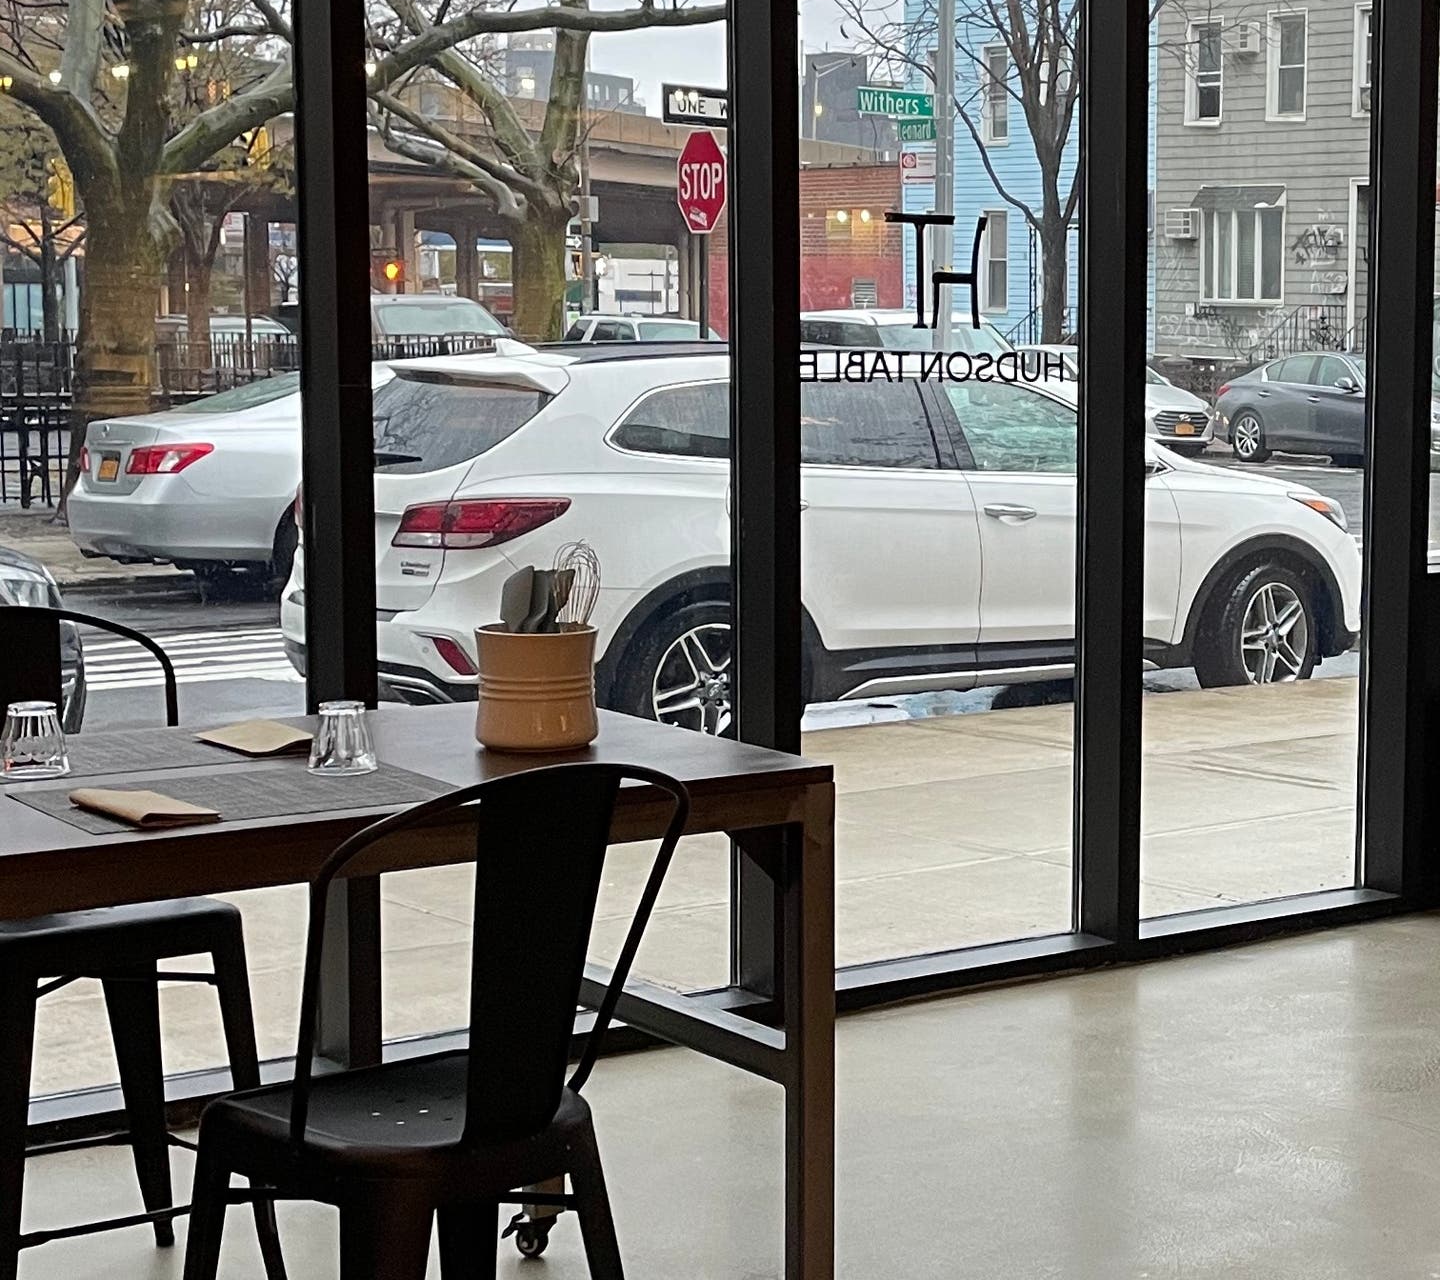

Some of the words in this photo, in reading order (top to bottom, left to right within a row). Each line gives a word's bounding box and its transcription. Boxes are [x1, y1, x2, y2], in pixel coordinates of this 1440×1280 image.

[677, 96, 707, 116] ONE
[860, 91, 919, 115] Withers
[898, 120, 932, 141] Leonard
[681, 162, 723, 200] STOP
